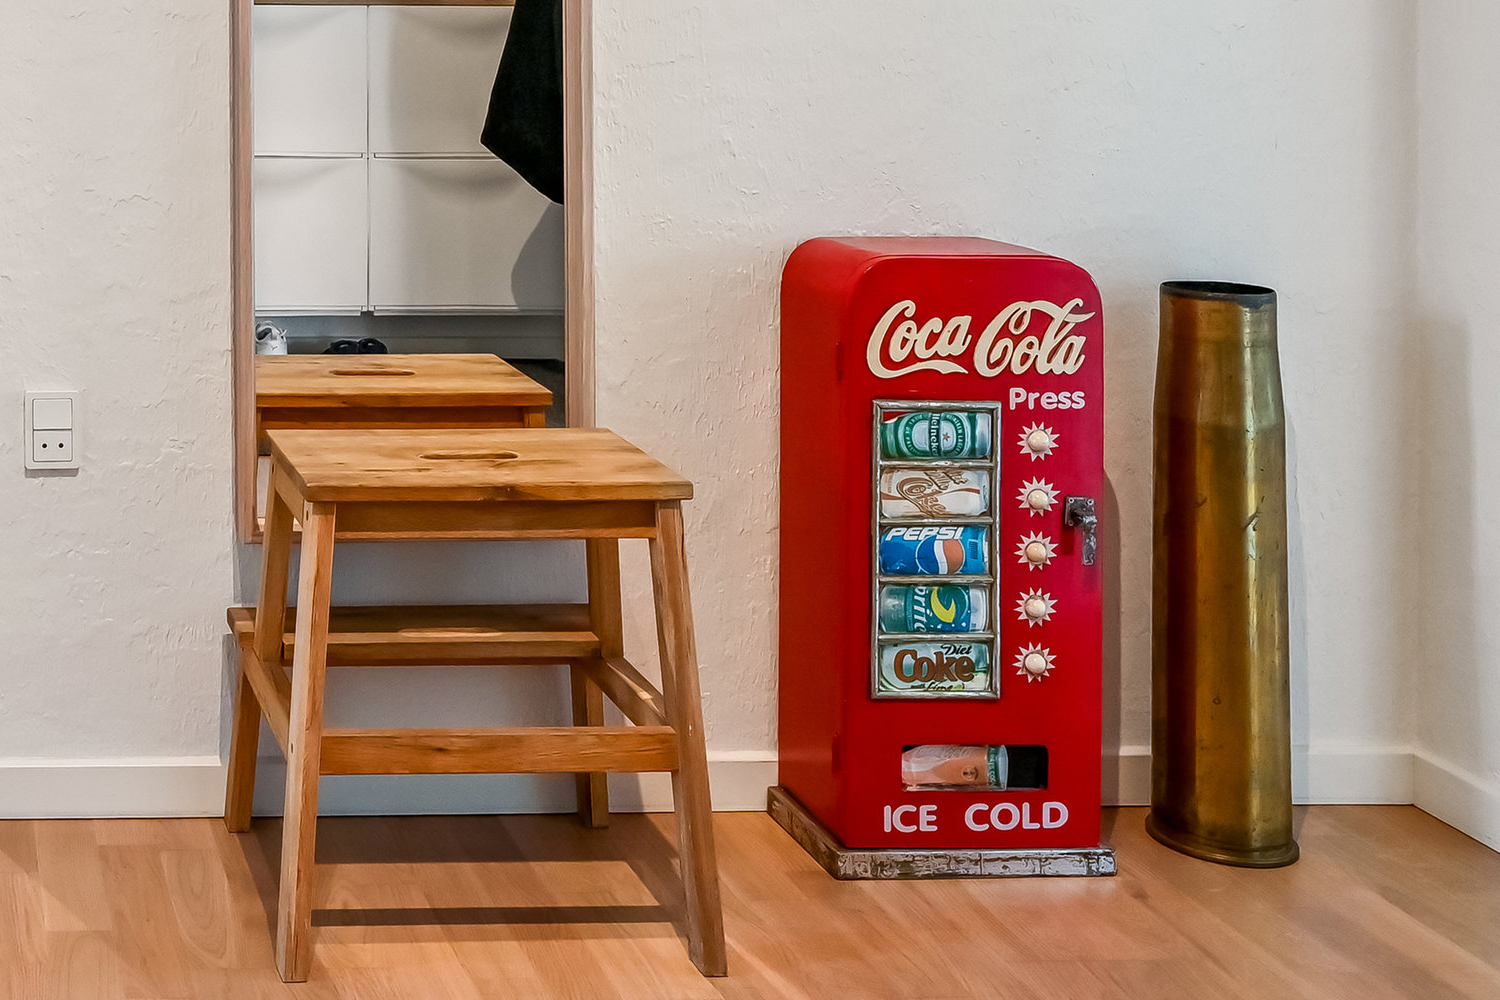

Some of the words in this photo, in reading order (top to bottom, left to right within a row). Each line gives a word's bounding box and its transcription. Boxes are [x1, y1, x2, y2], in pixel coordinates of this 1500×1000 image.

[867, 299, 972, 379] Coca
[973, 298, 1095, 377] Cola
[1009, 387, 1085, 410] Press
[885, 527, 964, 541] PEPSI
[913, 586, 933, 632] prite
[940, 643, 972, 655] Diet
[894, 649, 975, 683] Coke
[883, 804, 938, 833] ICE
[964, 801, 1069, 831] COLD
